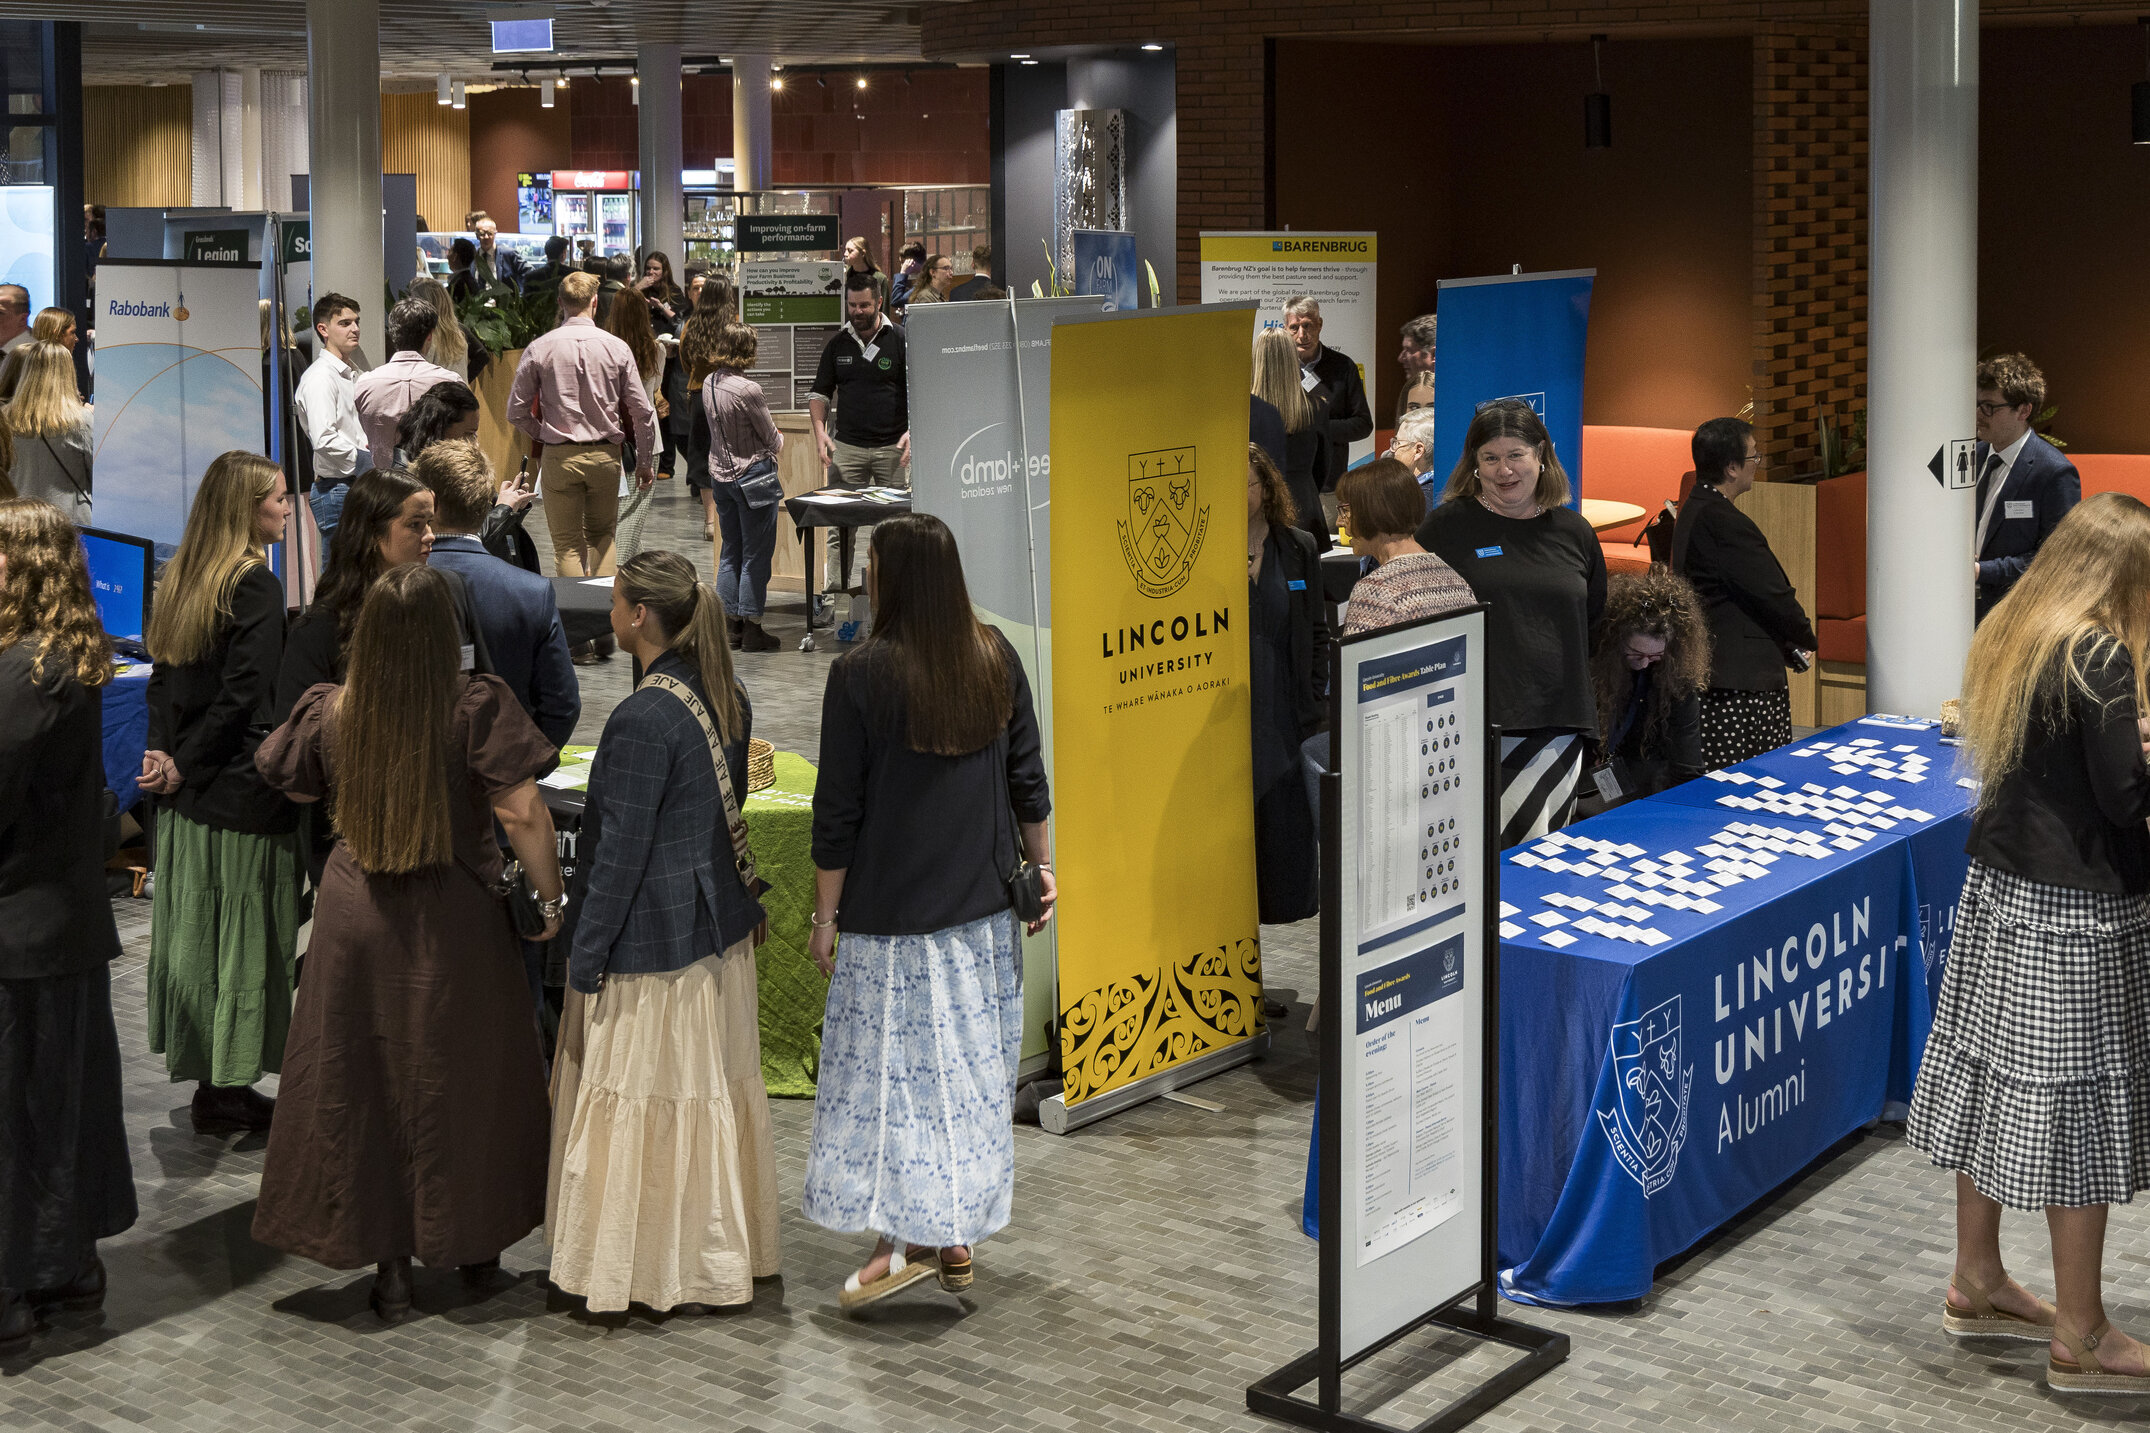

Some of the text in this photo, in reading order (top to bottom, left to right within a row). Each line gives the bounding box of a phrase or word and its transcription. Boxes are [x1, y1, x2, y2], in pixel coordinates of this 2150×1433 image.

[750, 223, 826, 234] Improving on-farm
[762, 234, 814, 244] performance
[1284, 241, 1368, 252] BARENBRUG
[1096, 256, 1112, 279] ON
[109, 300, 170, 318] Rabobank
[1121, 534, 1136, 570] SCIENTIA
[1189, 518, 1206, 559] PROBITATE
[1102, 608, 1230, 658] LINCOLN
[650, 674, 680, 689] AJE
[1120, 652, 1214, 684] UNIVERSITY
[1362, 682, 1376, 692] Food
[1376, 680, 1386, 688] and
[1386, 676, 1400, 685] Fibre
[1401, 669, 1420, 680] Awards
[1420, 666, 1434, 675] Table
[1434, 662, 1446, 671] Plan
[684, 691, 706, 717] AJE
[1103, 677, 1230, 715] TE WHARE WĀNAKA O AORAKI
[705, 722, 719, 750] AJE
[714, 754, 728, 781] AJE
[723, 786, 736, 813] AJE
[1714, 895, 1870, 1024] LINCOLN
[1441, 970, 1458, 981] LINCOLN
[1364, 988, 1375, 997] Food
[1375, 984, 1384, 993] and
[1365, 993, 1402, 1022] Menu
[1415, 1016, 1430, 1026] Menu
[1365, 1030, 1396, 1049] Order of the
[1365, 1043, 1388, 1058] evening:
[1716, 1058, 1806, 1154] Alumni
[1609, 1126, 1638, 1172] SCIENTIA
